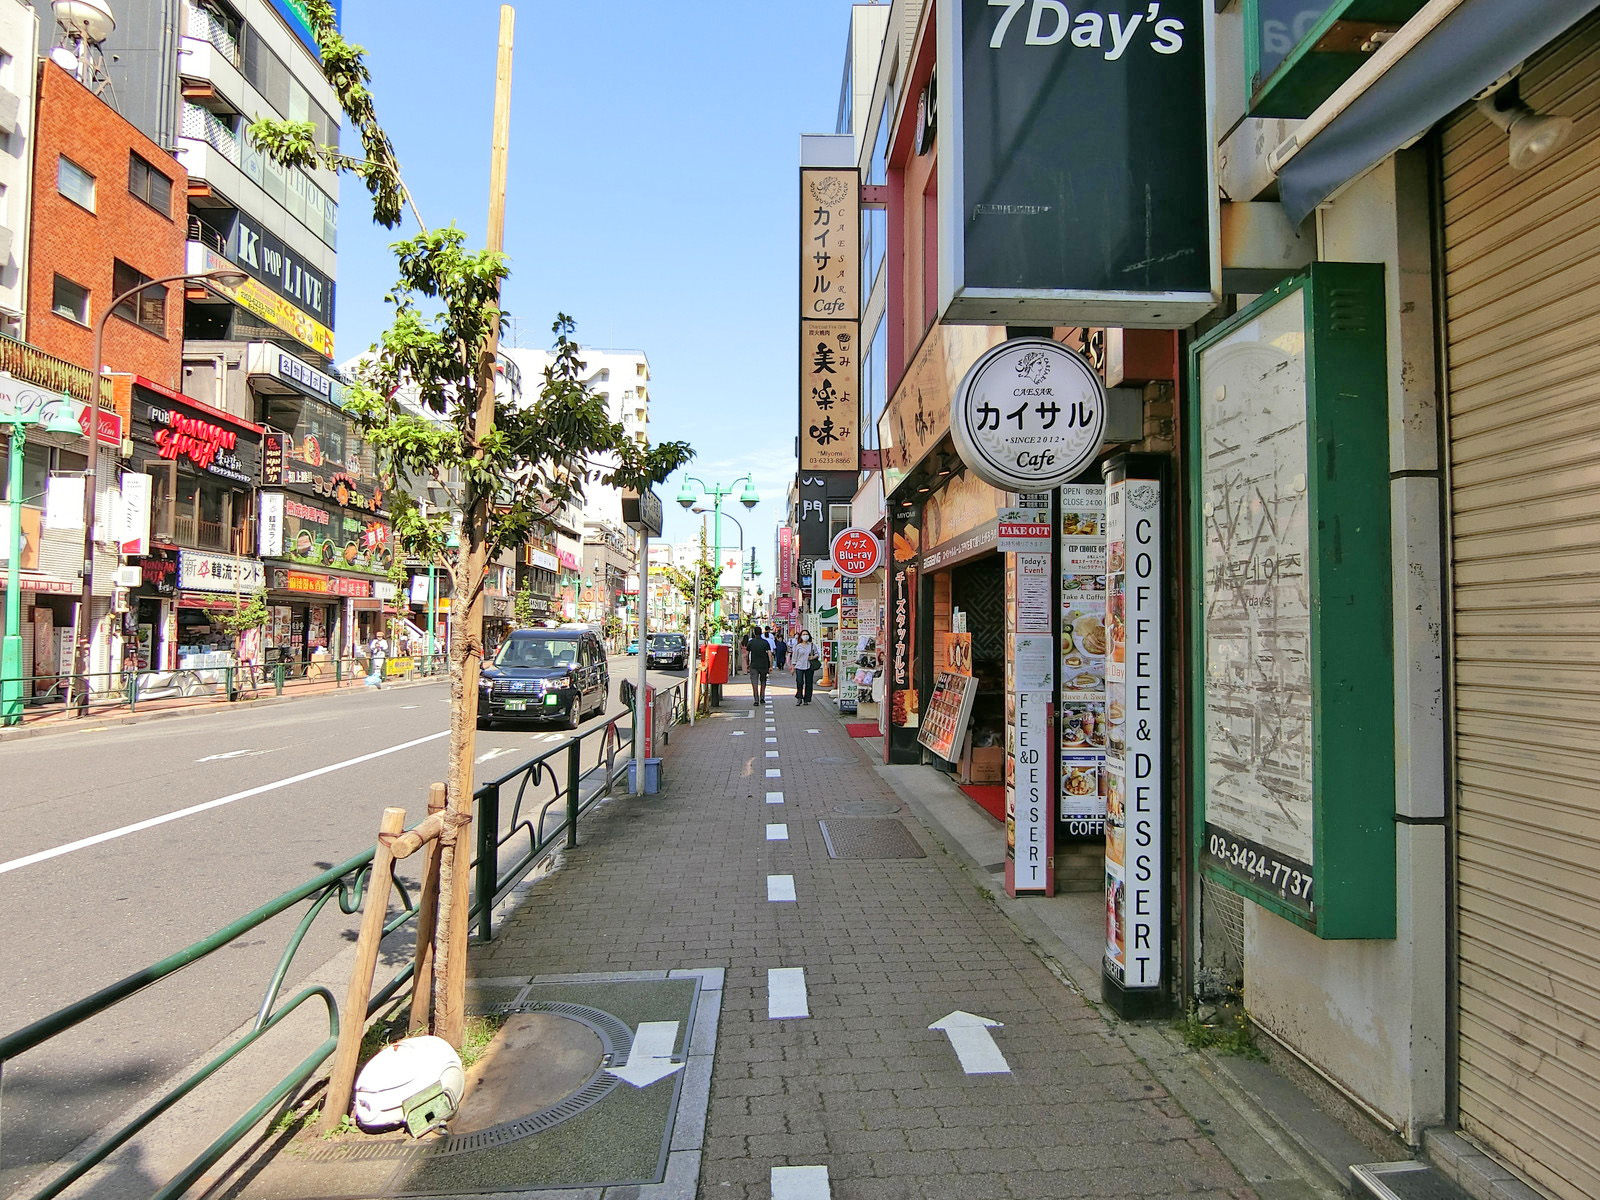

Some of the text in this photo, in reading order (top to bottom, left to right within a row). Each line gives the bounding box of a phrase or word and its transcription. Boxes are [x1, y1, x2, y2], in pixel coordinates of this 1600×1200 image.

[813, 206, 831, 294] カイサル
[836, 208, 847, 294] CAESAR
[238, 222, 260, 270] K
[264, 247, 281, 276] POP
[284, 257, 322, 312] LIVE
[813, 297, 845, 315] Cafe
[1013, 388, 1054, 397] CAESAR
[151, 407, 170, 424] PUB
[976, 401, 1094, 431] カイサル
[1010, 436, 1036, 444] SINCE
[1016, 449, 1055, 471] Cafe
[1063, 487, 1103, 496] OPEN 09:30
[1063, 498, 1084, 506] CLOSE
[1000, 527, 1050, 535] TAKE OUT
[840, 551, 873, 560] Blu-ray
[1021, 556, 1047, 566] Today's
[847, 561, 866, 570] DVD
[1135, 518, 1152, 984] COFFEE & DESSERT
[1029, 750, 1039, 881] DESSERT
[1210, 833, 1313, 900] 03-3424-7737
